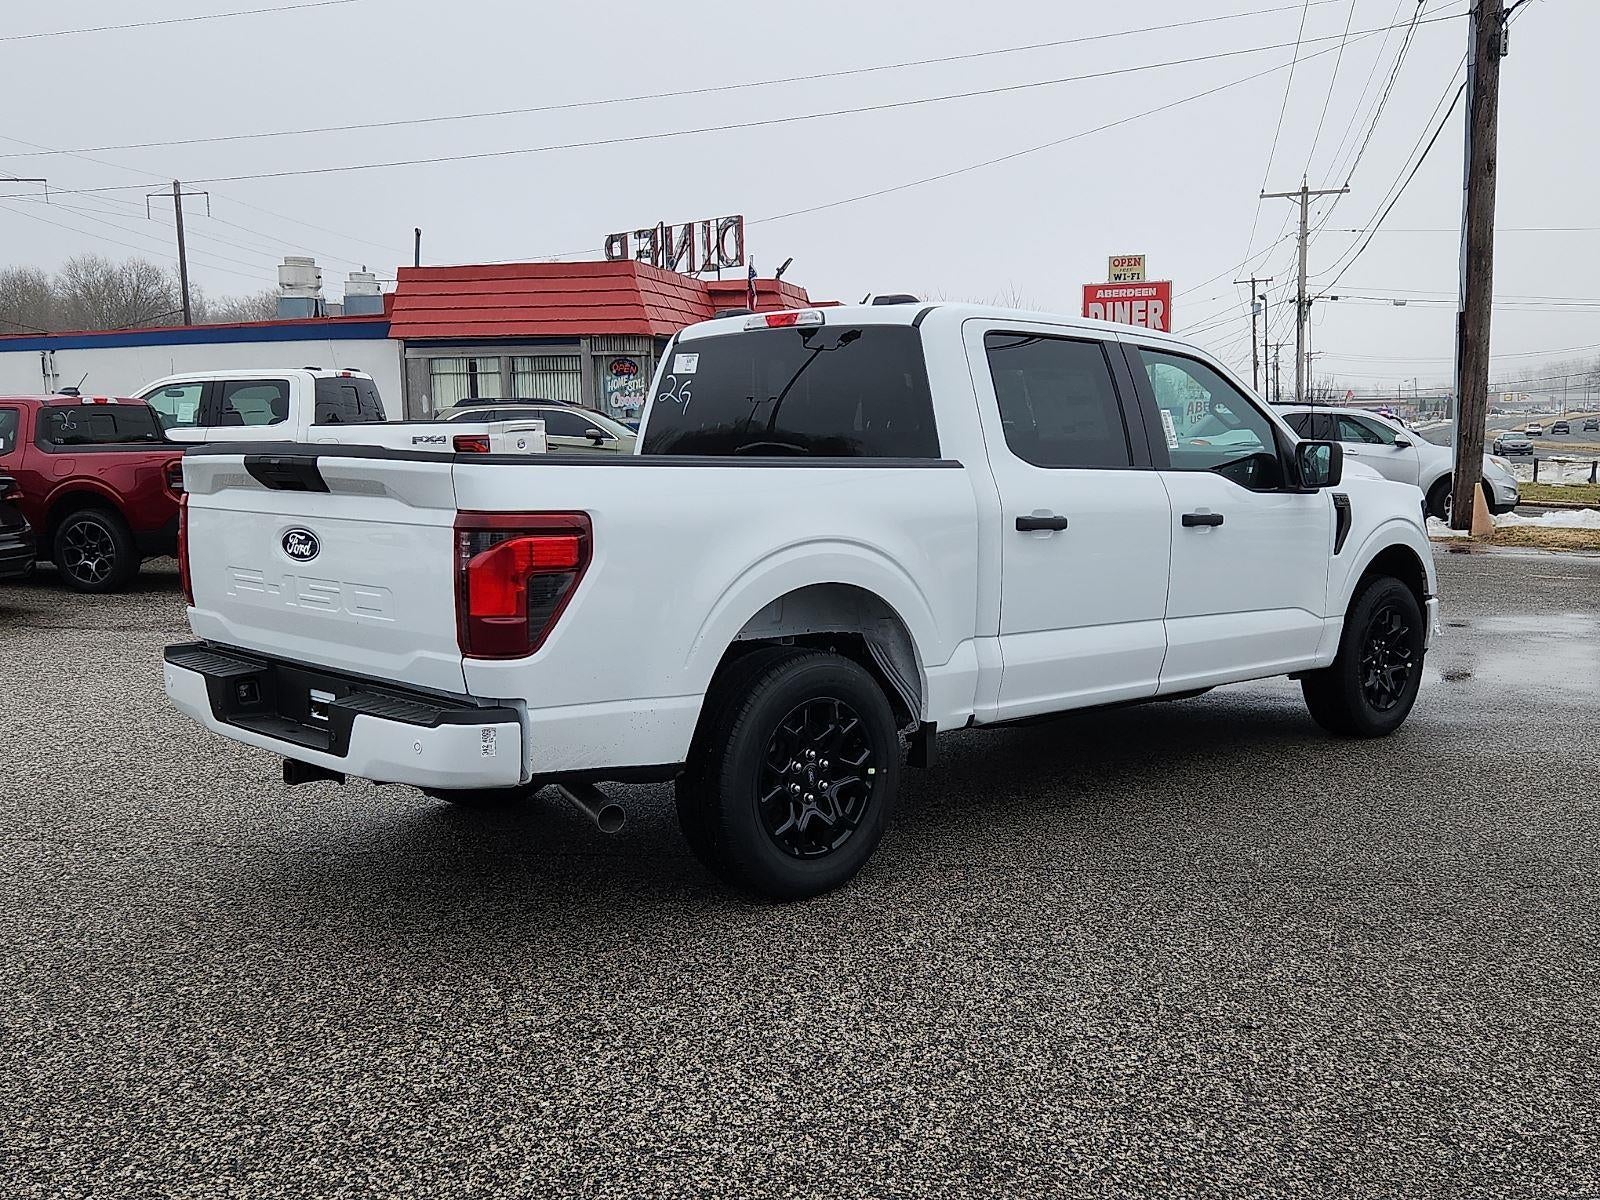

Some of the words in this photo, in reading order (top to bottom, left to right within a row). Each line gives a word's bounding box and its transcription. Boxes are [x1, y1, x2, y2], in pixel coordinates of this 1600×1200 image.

[1113, 258, 1141, 267] OPEN
[1113, 273, 1140, 281] WI-FI
[1096, 288, 1157, 298] ABERDEEN
[1088, 300, 1164, 329] DINER
[612, 361, 637, 375] OPEN
[608, 377, 628, 391] HOME
[412, 436, 447, 444] FX4
[286, 533, 312, 556] Ford
[225, 565, 396, 622] F-150
